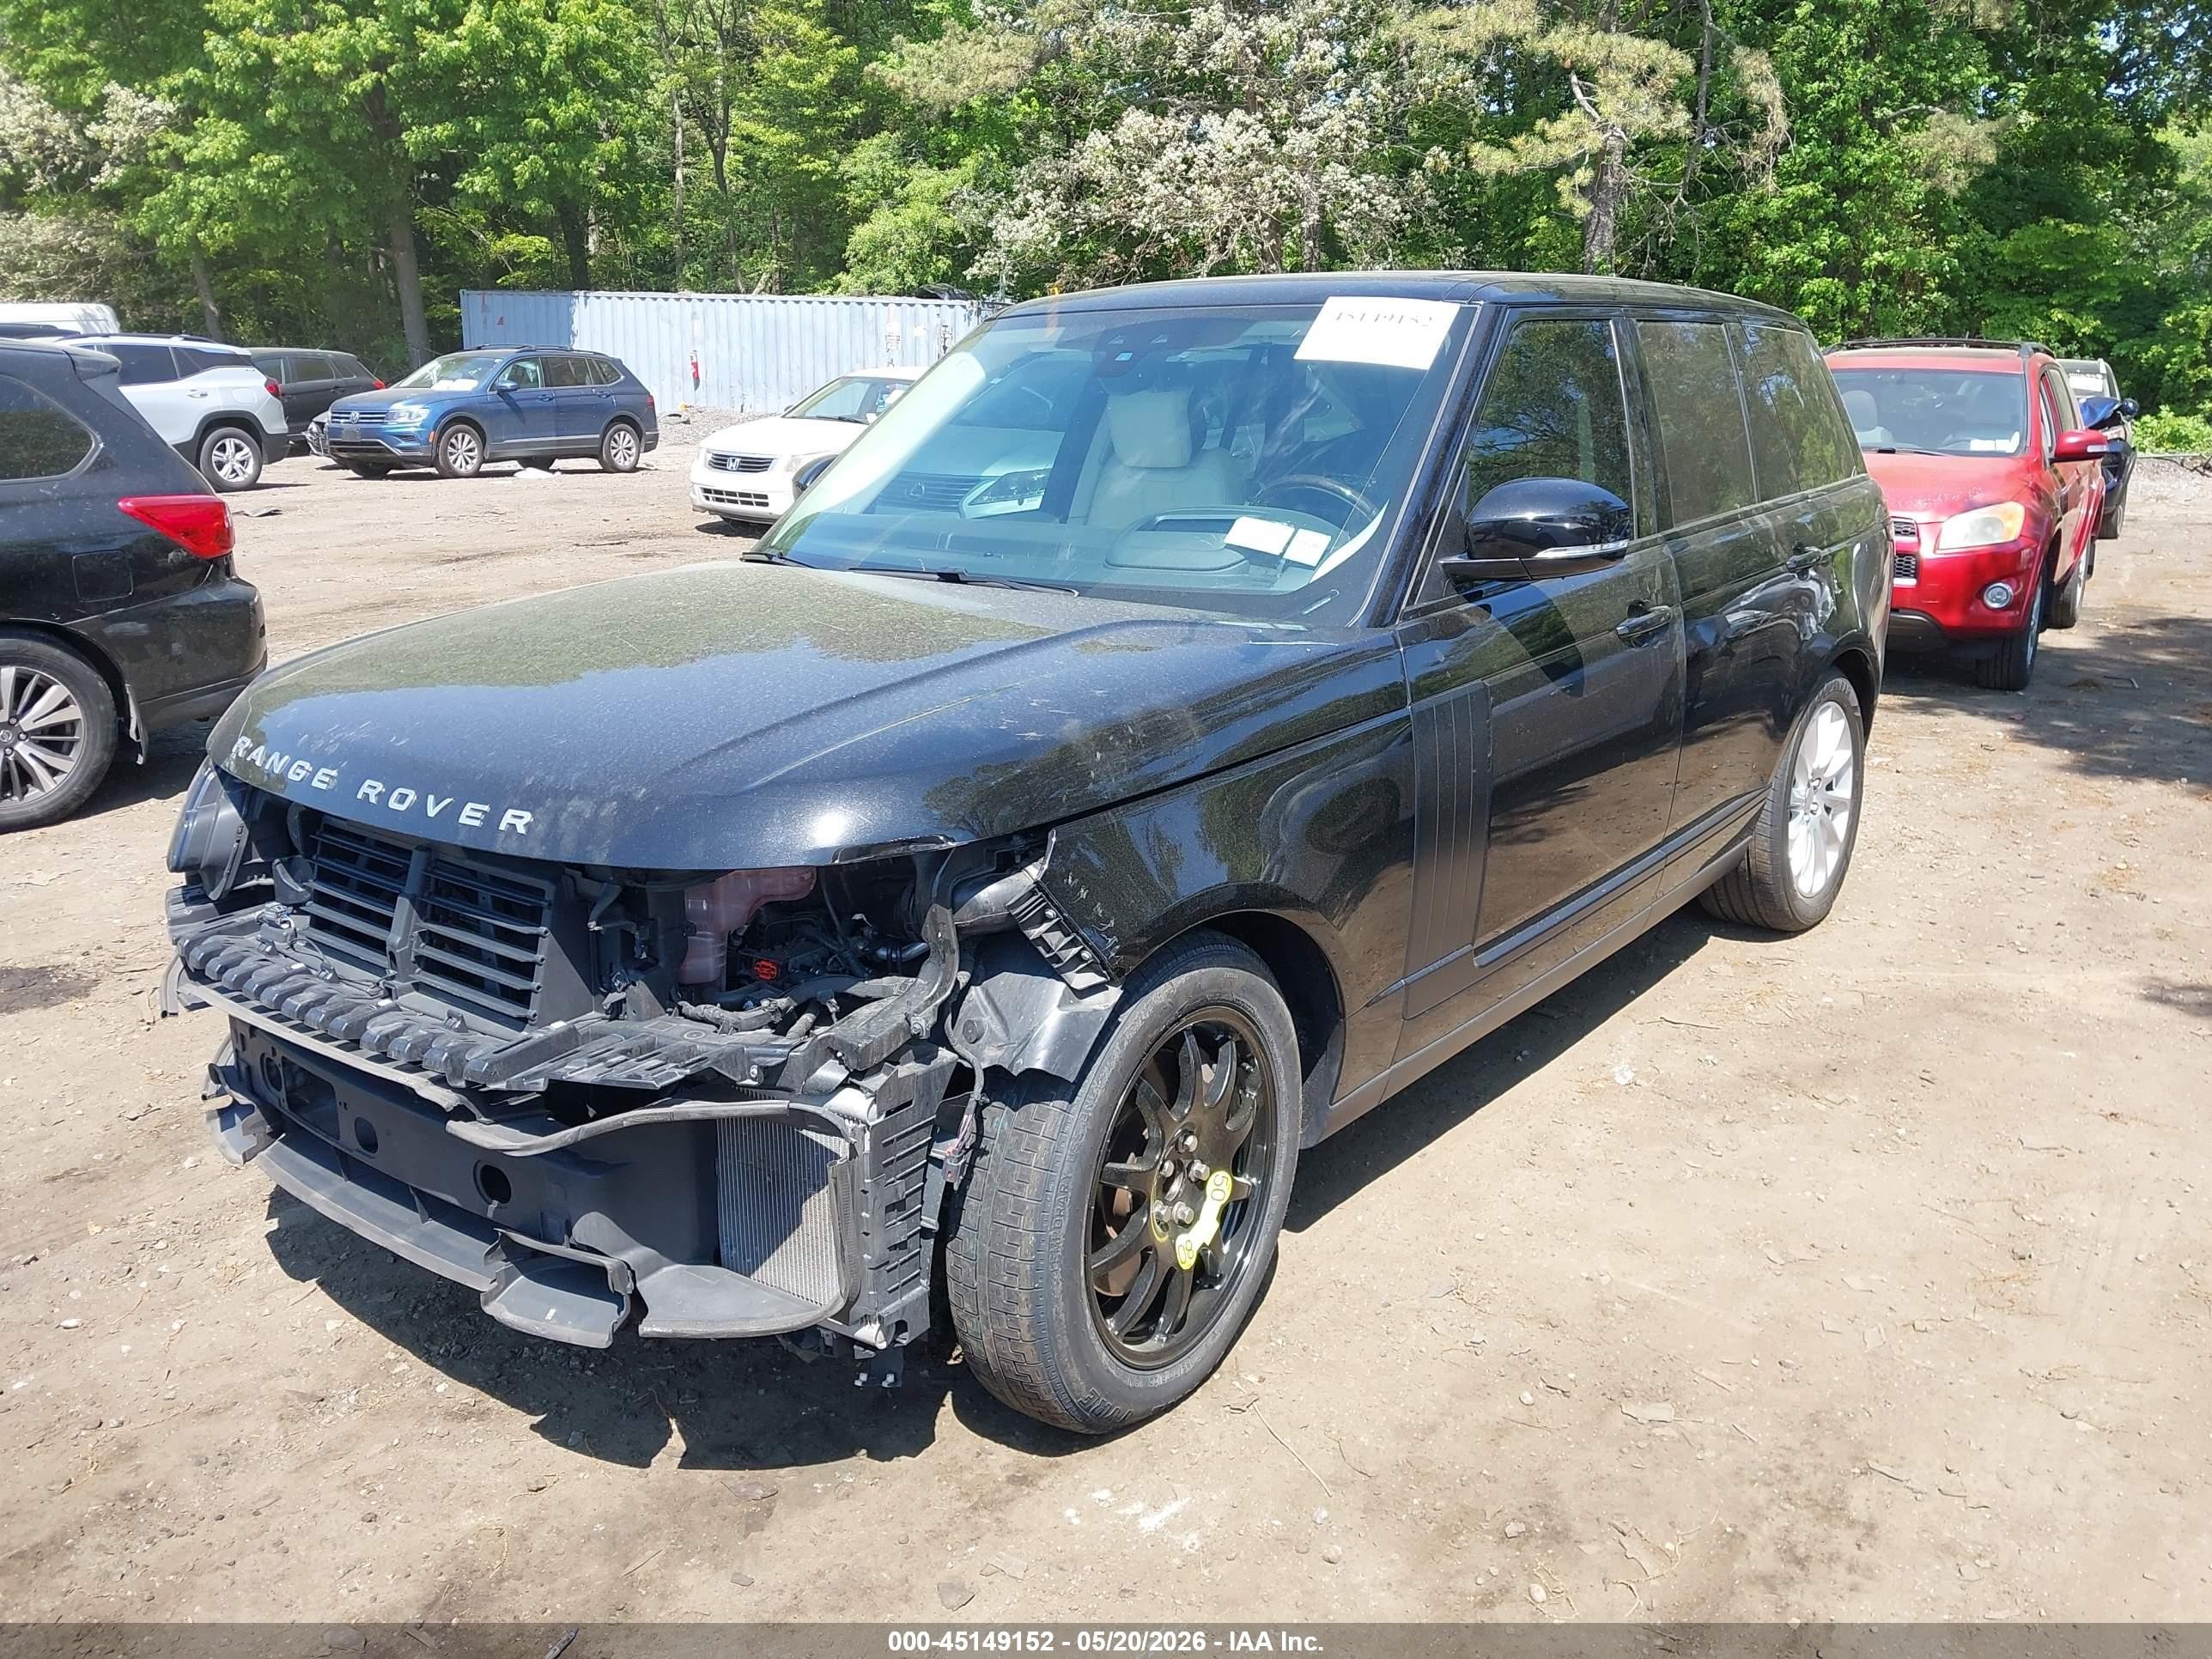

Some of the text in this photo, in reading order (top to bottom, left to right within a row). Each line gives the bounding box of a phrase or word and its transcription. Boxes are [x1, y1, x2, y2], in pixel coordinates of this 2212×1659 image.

[231, 736, 535, 835] RANGE ROVER
[1211, 1174, 1229, 1201] 50
[1177, 1239, 1194, 1265] 80
